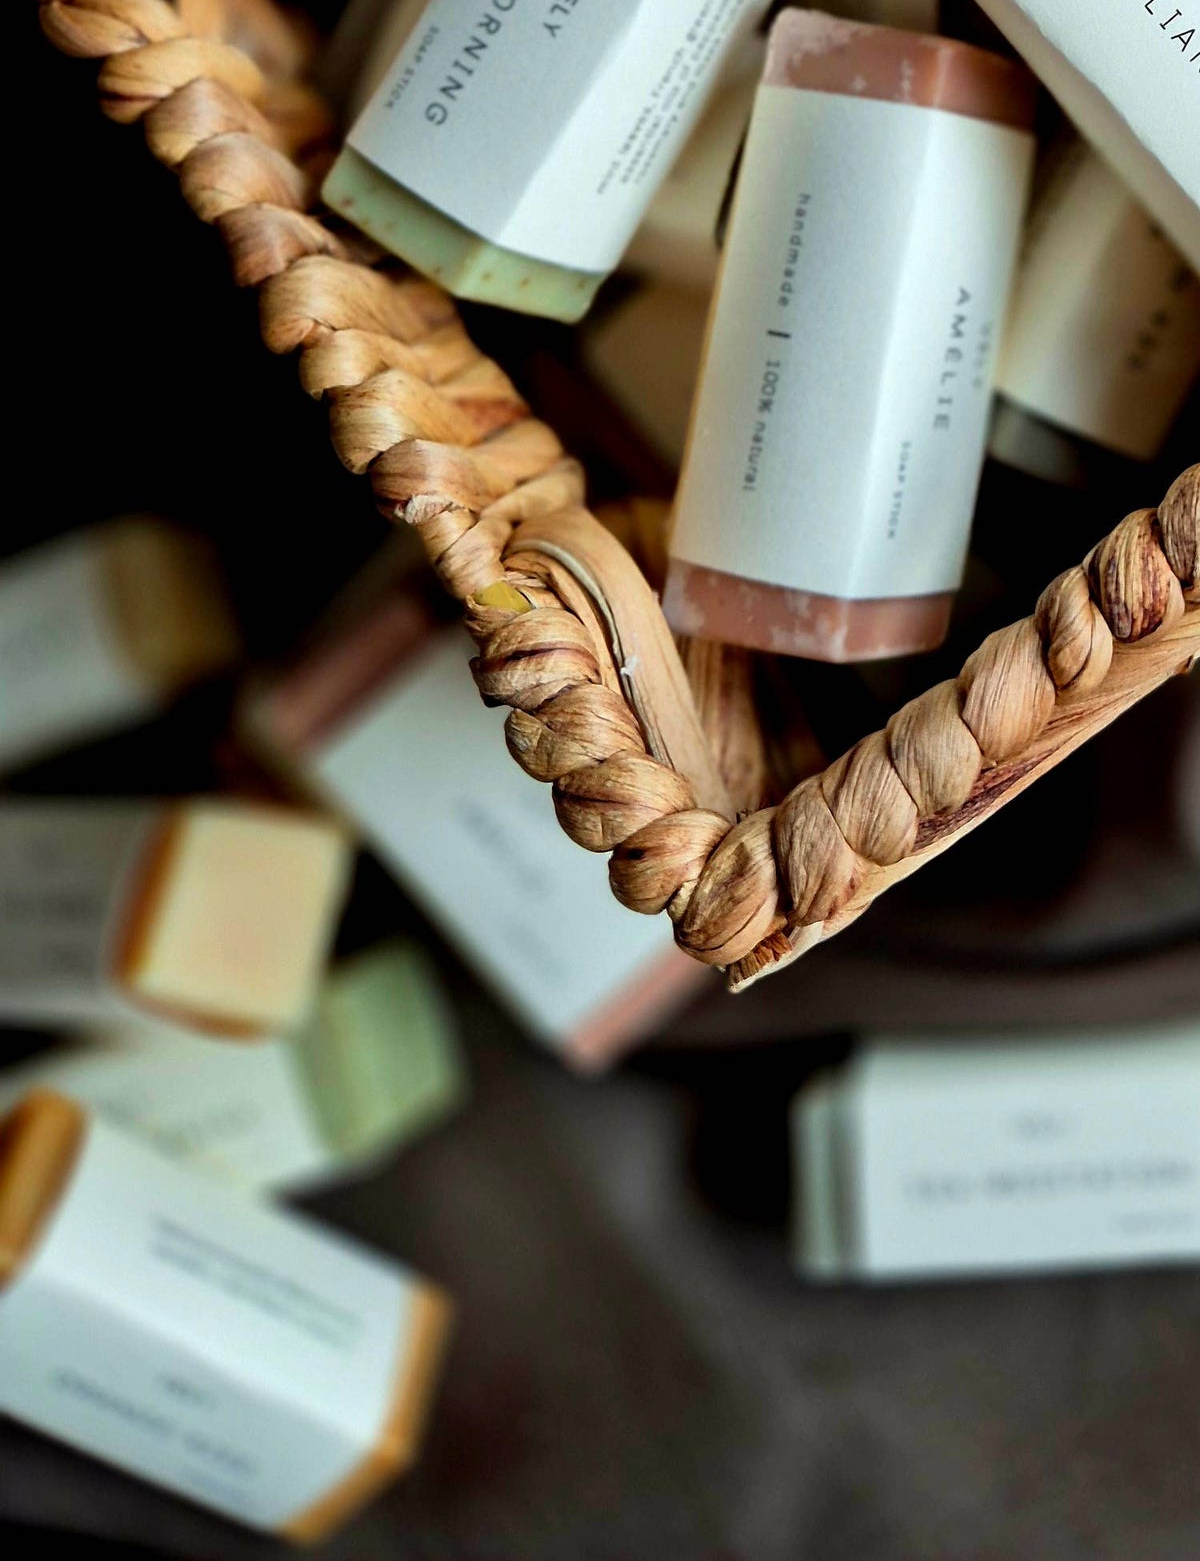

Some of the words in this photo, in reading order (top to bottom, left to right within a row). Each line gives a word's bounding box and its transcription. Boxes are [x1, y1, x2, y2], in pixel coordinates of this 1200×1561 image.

[777, 193, 812, 307] handmade
[757, 359, 781, 413] 100%
[742, 421, 766, 491] natural
